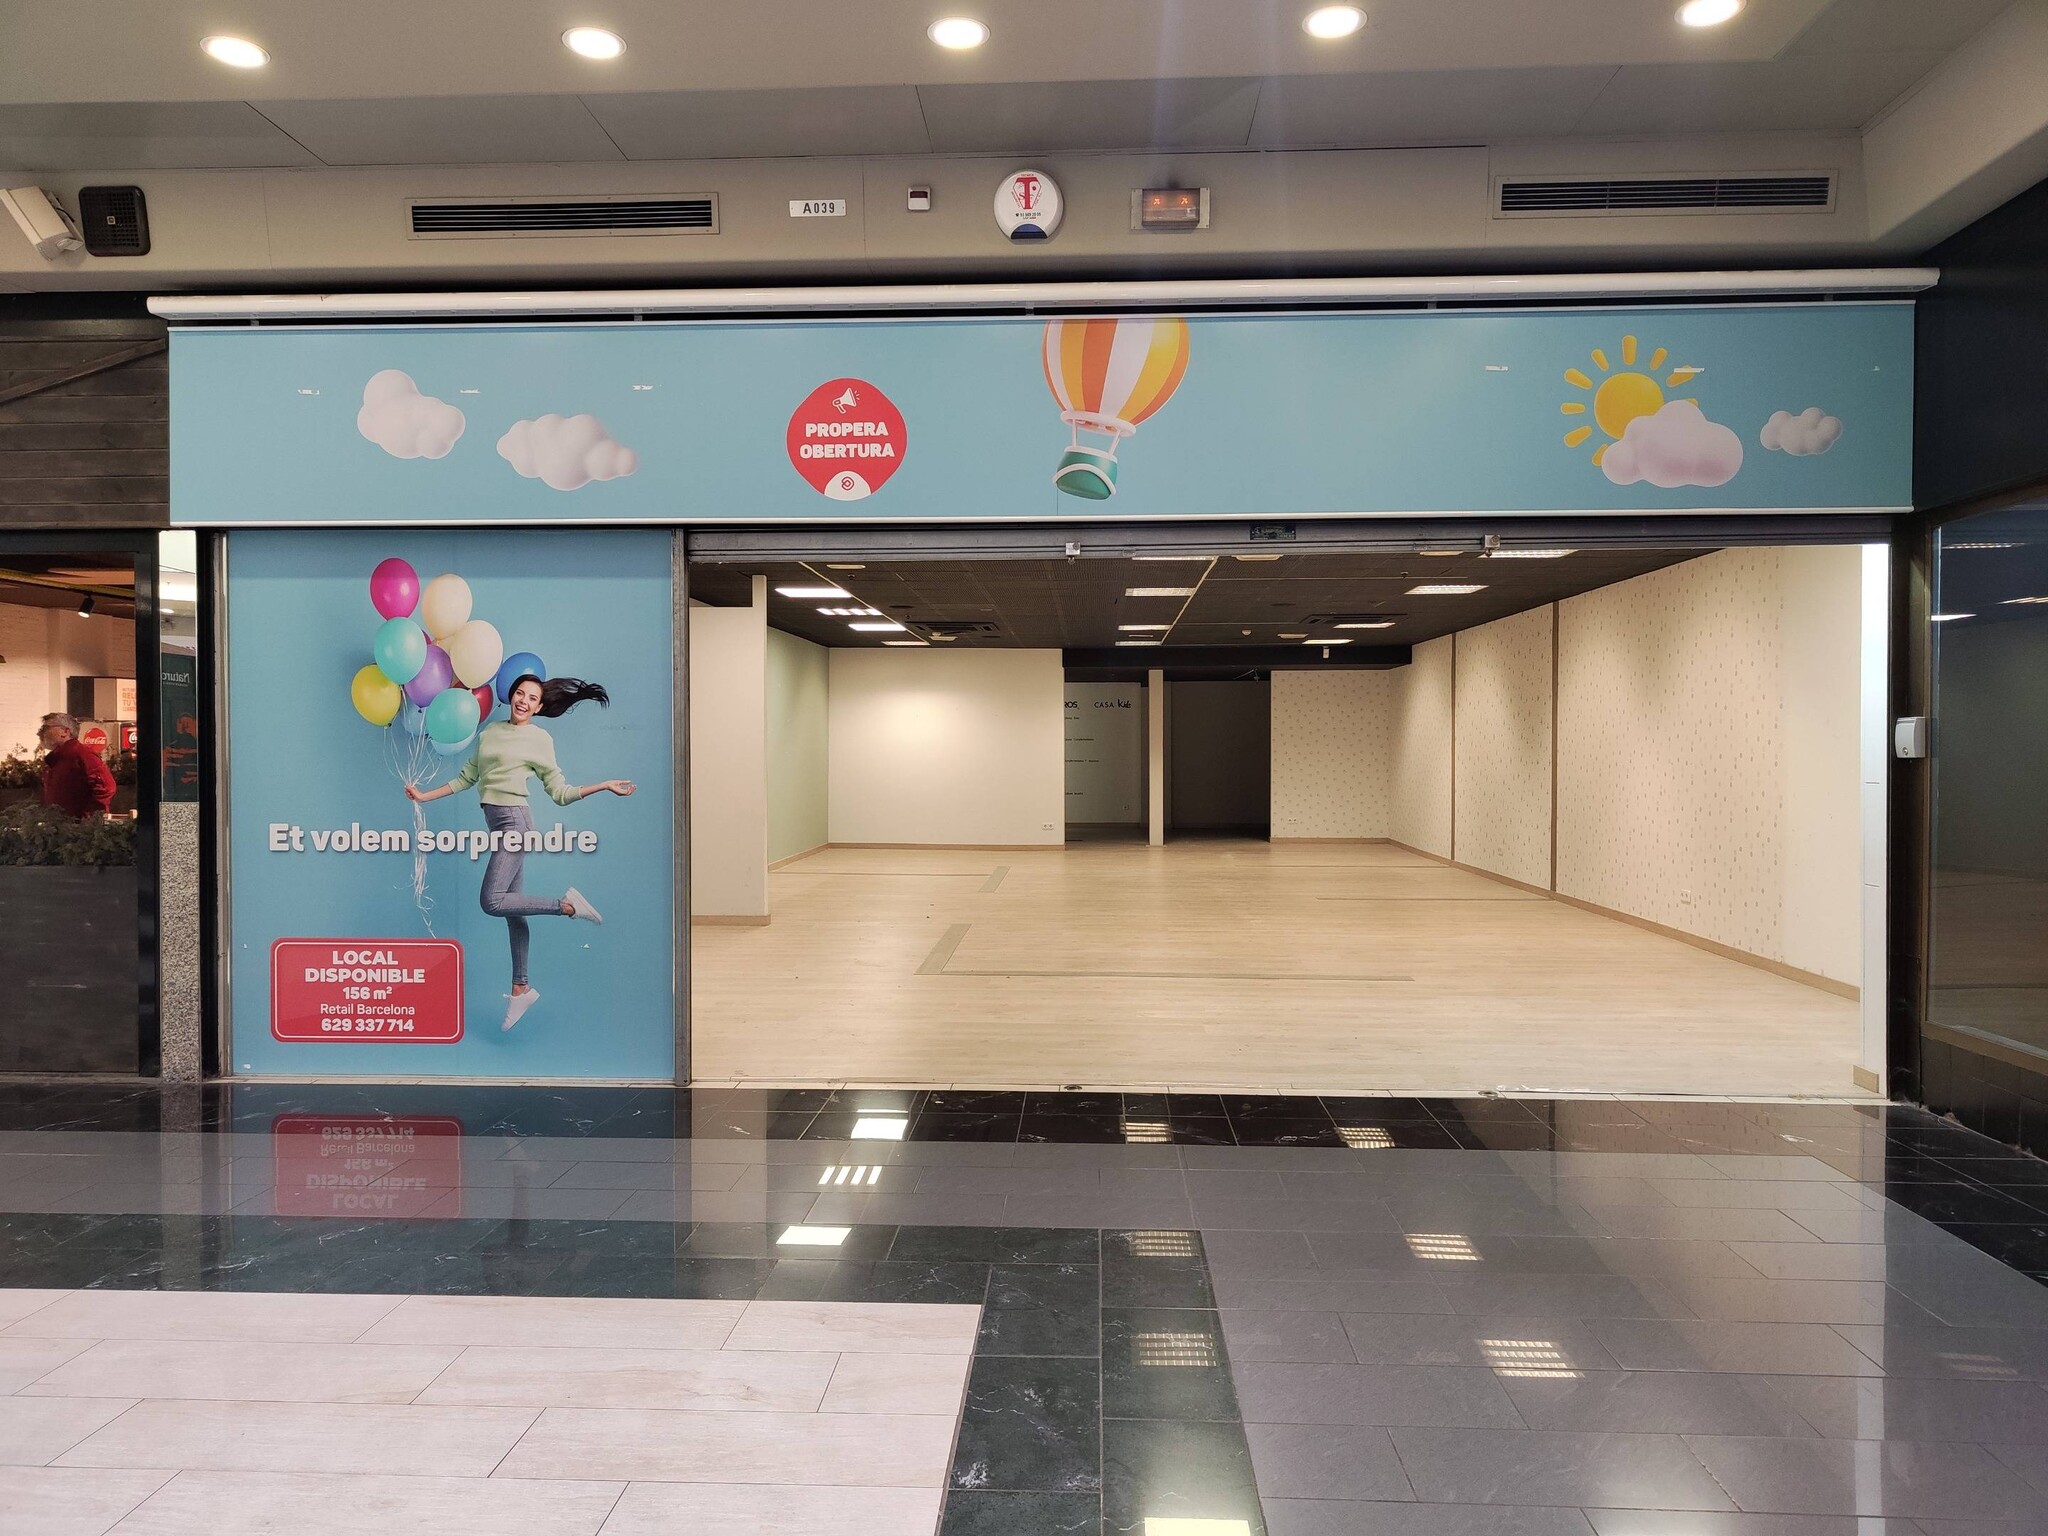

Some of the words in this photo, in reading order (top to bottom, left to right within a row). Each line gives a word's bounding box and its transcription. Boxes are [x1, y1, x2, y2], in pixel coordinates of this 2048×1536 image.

[803, 202, 835, 214] A039
[805, 422, 889, 438] PROPERA
[800, 443, 895, 459] OBERTURA
[269, 822, 304, 852] Et
[311, 822, 410, 852] volem
[416, 822, 598, 860] sorprendre
[332, 951, 399, 965] LOCAL
[304, 968, 426, 983] DISPONIBLE
[342, 987, 370, 1000] 156
[320, 1003, 354, 1015] Retail
[357, 1003, 415, 1015] Barcelona
[321, 1018, 351, 1032] 629
[355, 1018, 385, 1032] 337
[387, 1018, 414, 1032] 714
